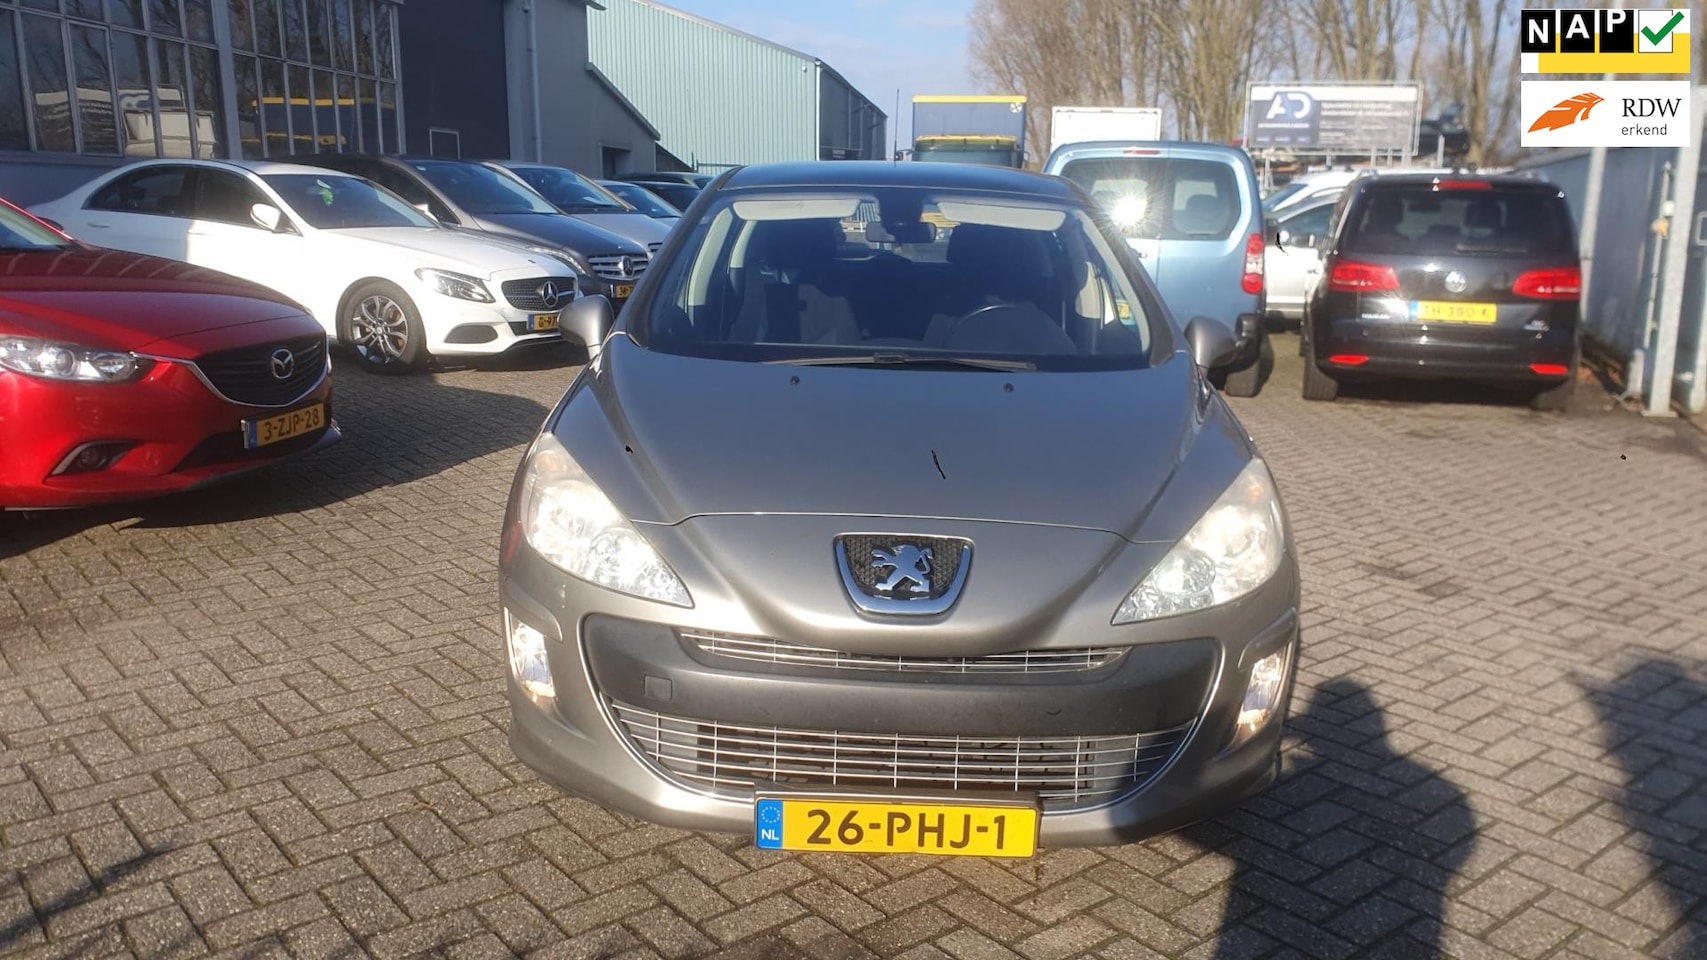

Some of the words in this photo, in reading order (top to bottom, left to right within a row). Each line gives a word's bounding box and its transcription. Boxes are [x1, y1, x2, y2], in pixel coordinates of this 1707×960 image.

[264, 408, 320, 441] 3-ZJP-28
[761, 829, 780, 841] NL
[806, 809, 1006, 850] 26-PHJ-1
